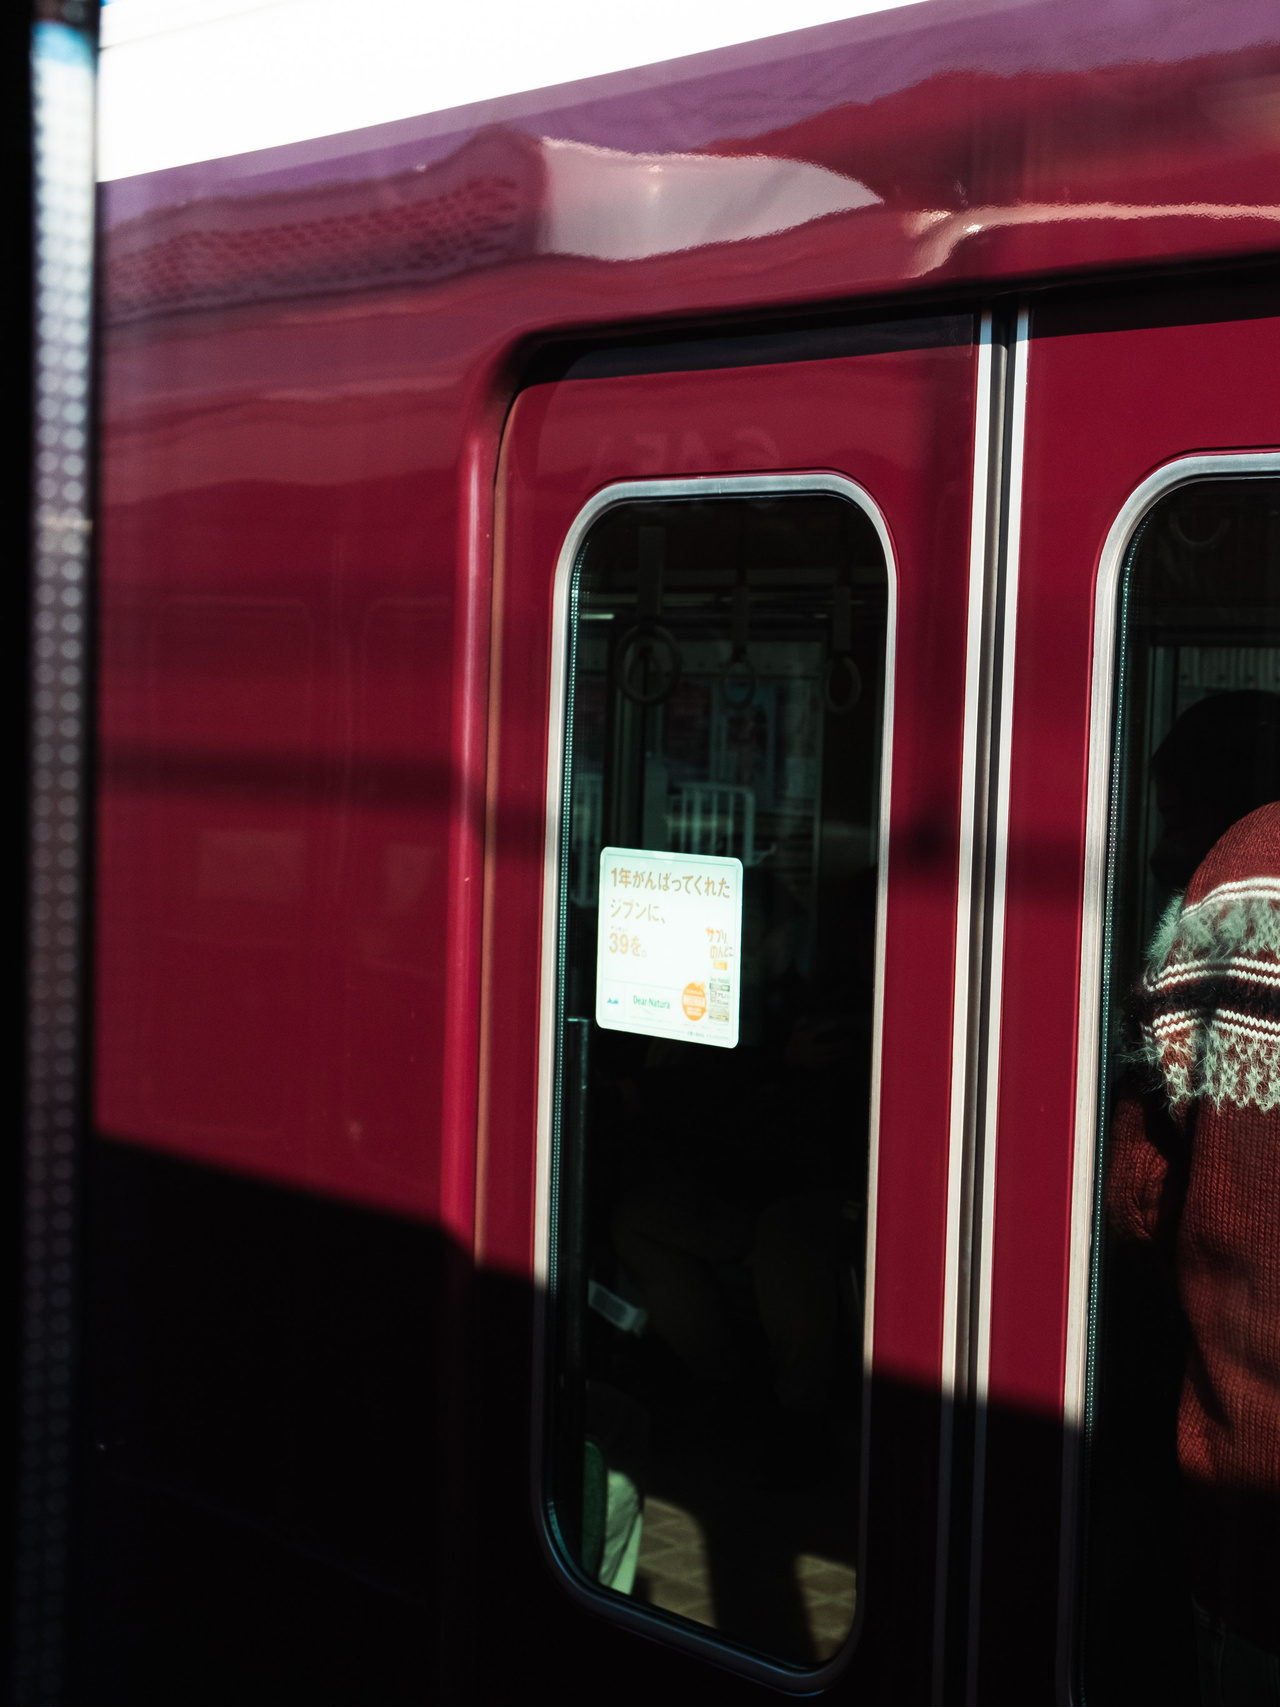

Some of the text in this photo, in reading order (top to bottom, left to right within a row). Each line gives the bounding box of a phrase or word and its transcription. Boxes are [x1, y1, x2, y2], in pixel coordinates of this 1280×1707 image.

[611, 867, 730, 899] 1年がんばってくれた
